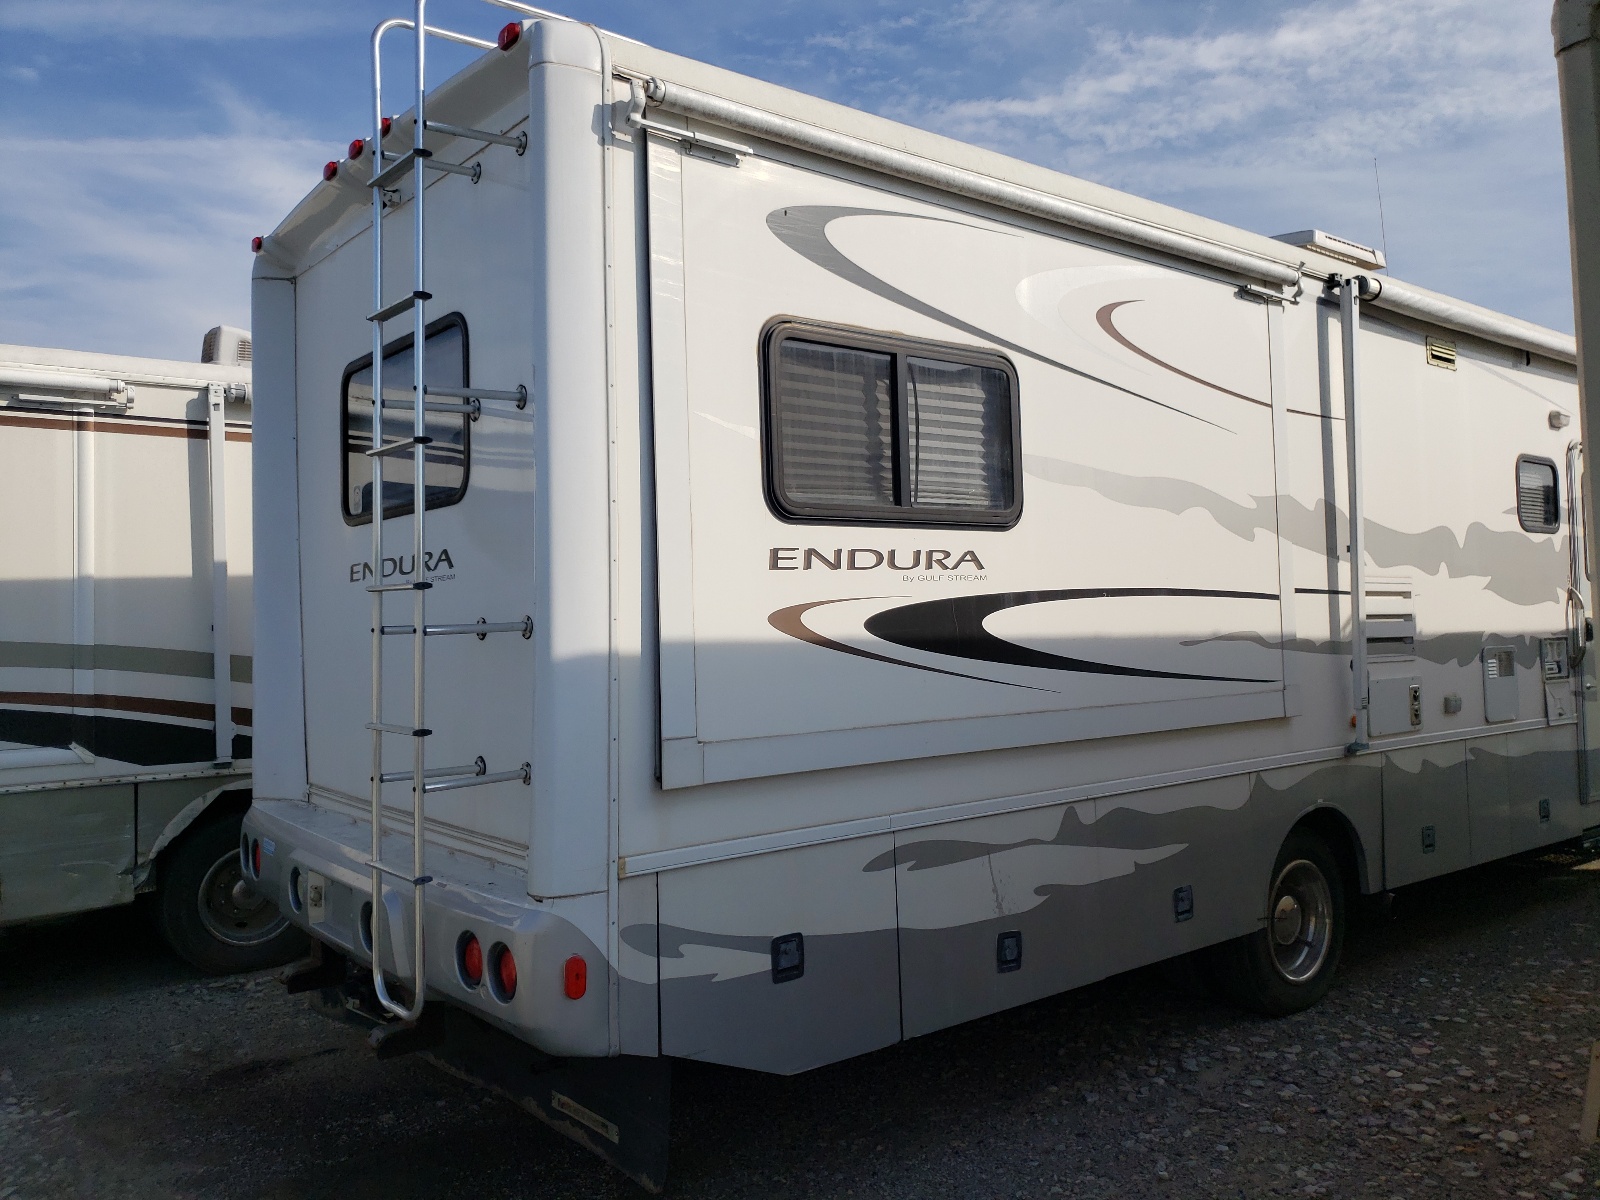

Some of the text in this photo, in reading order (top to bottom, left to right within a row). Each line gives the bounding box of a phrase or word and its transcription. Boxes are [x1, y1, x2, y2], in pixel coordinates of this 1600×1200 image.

[769, 547, 986, 570] ENDURA
[430, 573, 456, 583] STREAM
[902, 574, 915, 582] By
